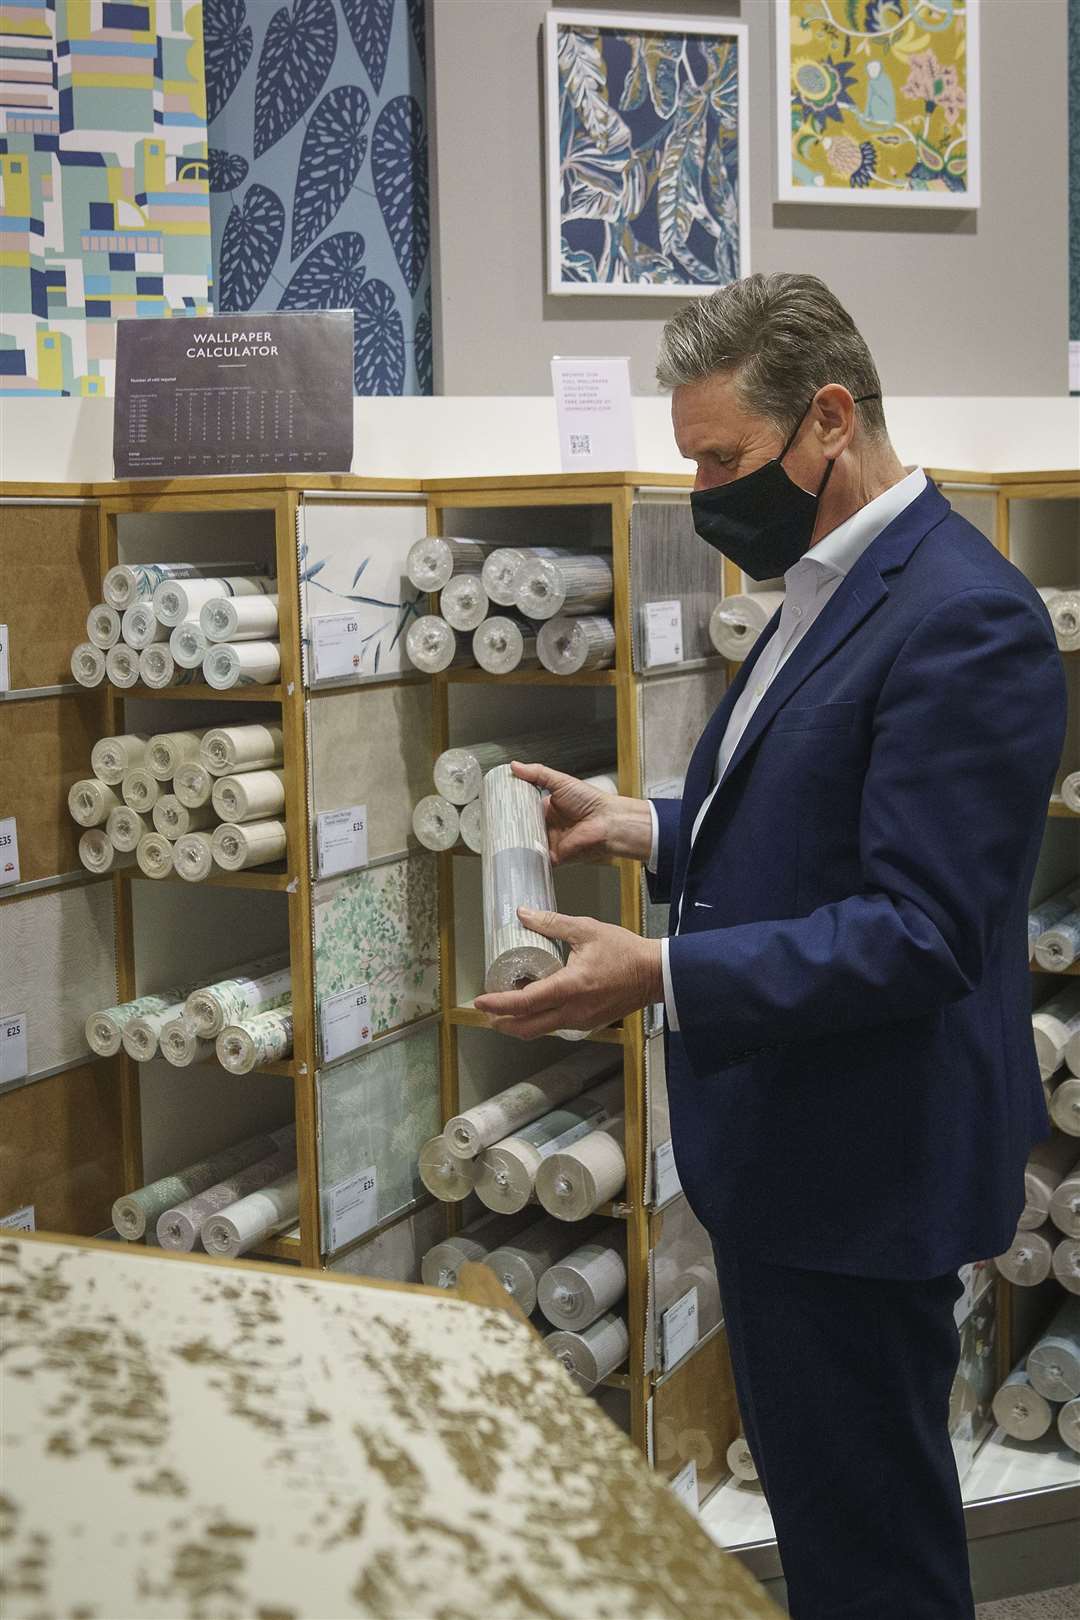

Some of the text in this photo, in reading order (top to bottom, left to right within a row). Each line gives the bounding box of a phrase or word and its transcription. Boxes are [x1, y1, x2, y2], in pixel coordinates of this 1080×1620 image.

[193, 331, 272, 344] WALLPAPER
[186, 345, 279, 359] CALCULATOR
[347, 622, 358, 632] £30
[356, 994, 367, 1006] £25
[7, 1025, 20, 1037] £25
[364, 1178, 374, 1190] £25
